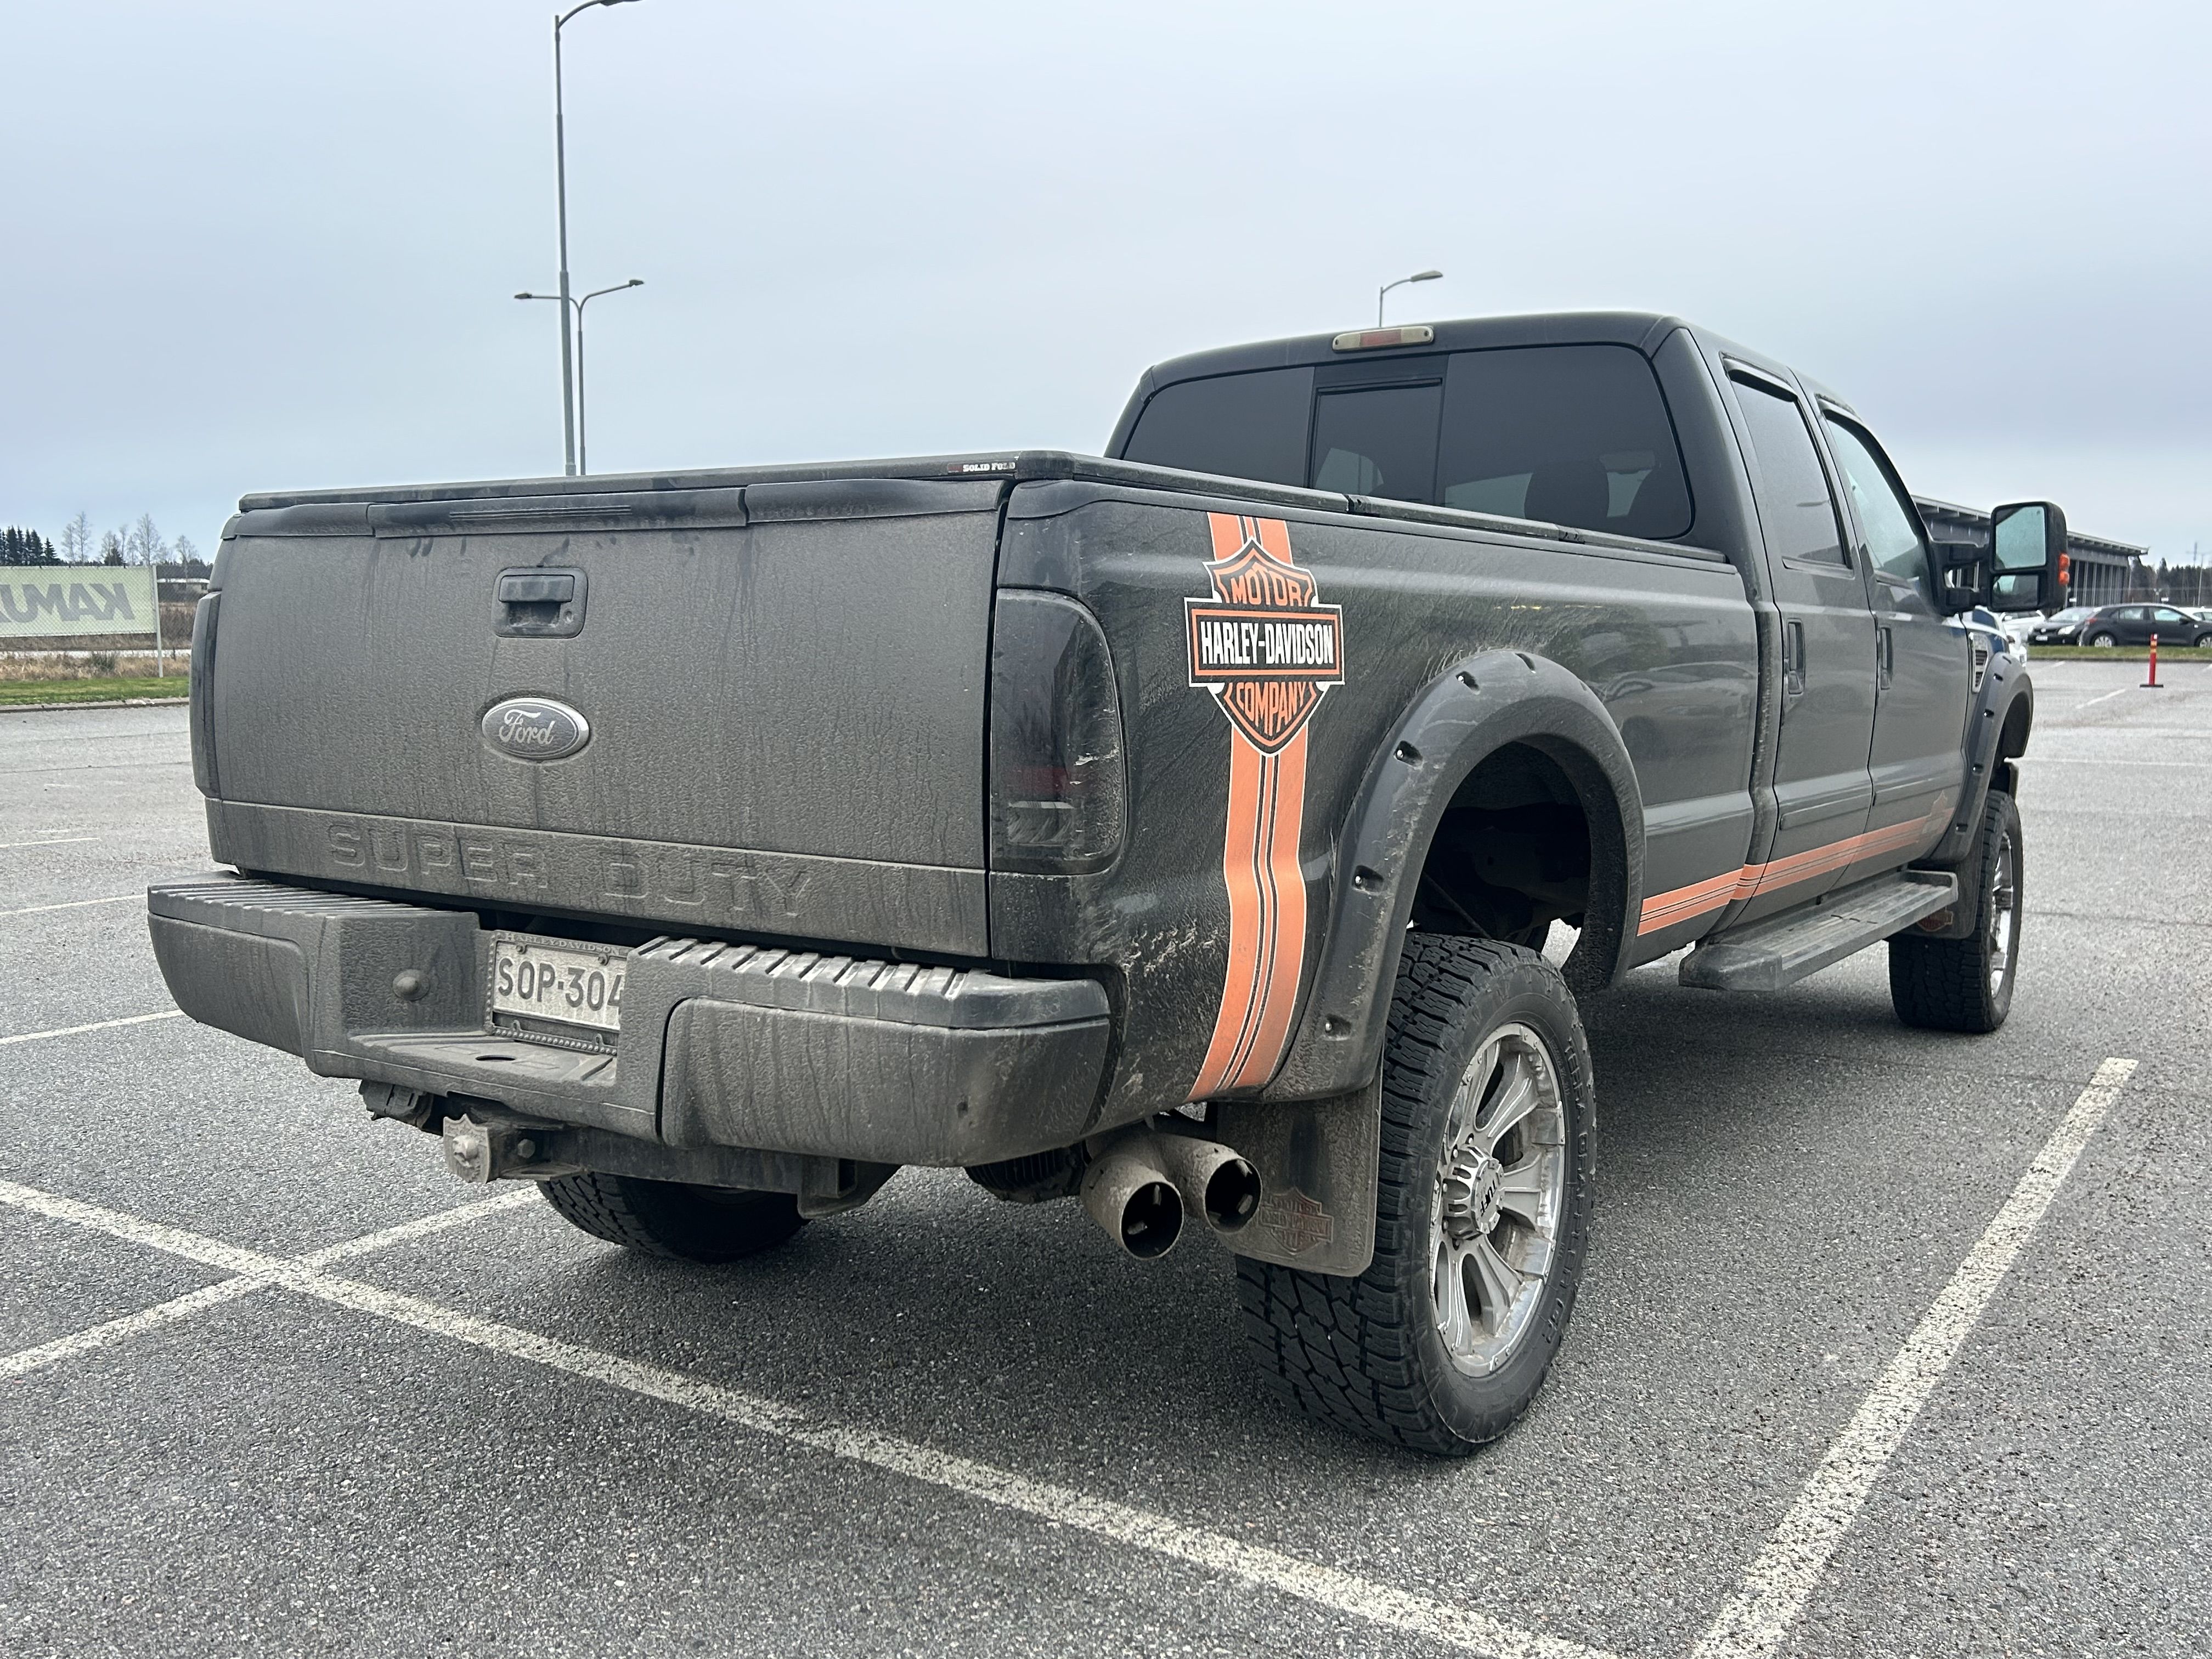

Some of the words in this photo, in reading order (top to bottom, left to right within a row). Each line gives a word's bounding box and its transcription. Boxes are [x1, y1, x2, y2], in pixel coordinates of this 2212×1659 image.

[963, 464, 990, 472] SOLID
[1230, 562, 1301, 607] MOTOR
[1200, 622, 1334, 665] HARLEY-DAVIDSON
[498, 709, 556, 744] Ford
[1235, 681, 1306, 736] COMPANY
[329, 824, 549, 890] SUPER
[601, 850, 811, 917] DUTY
